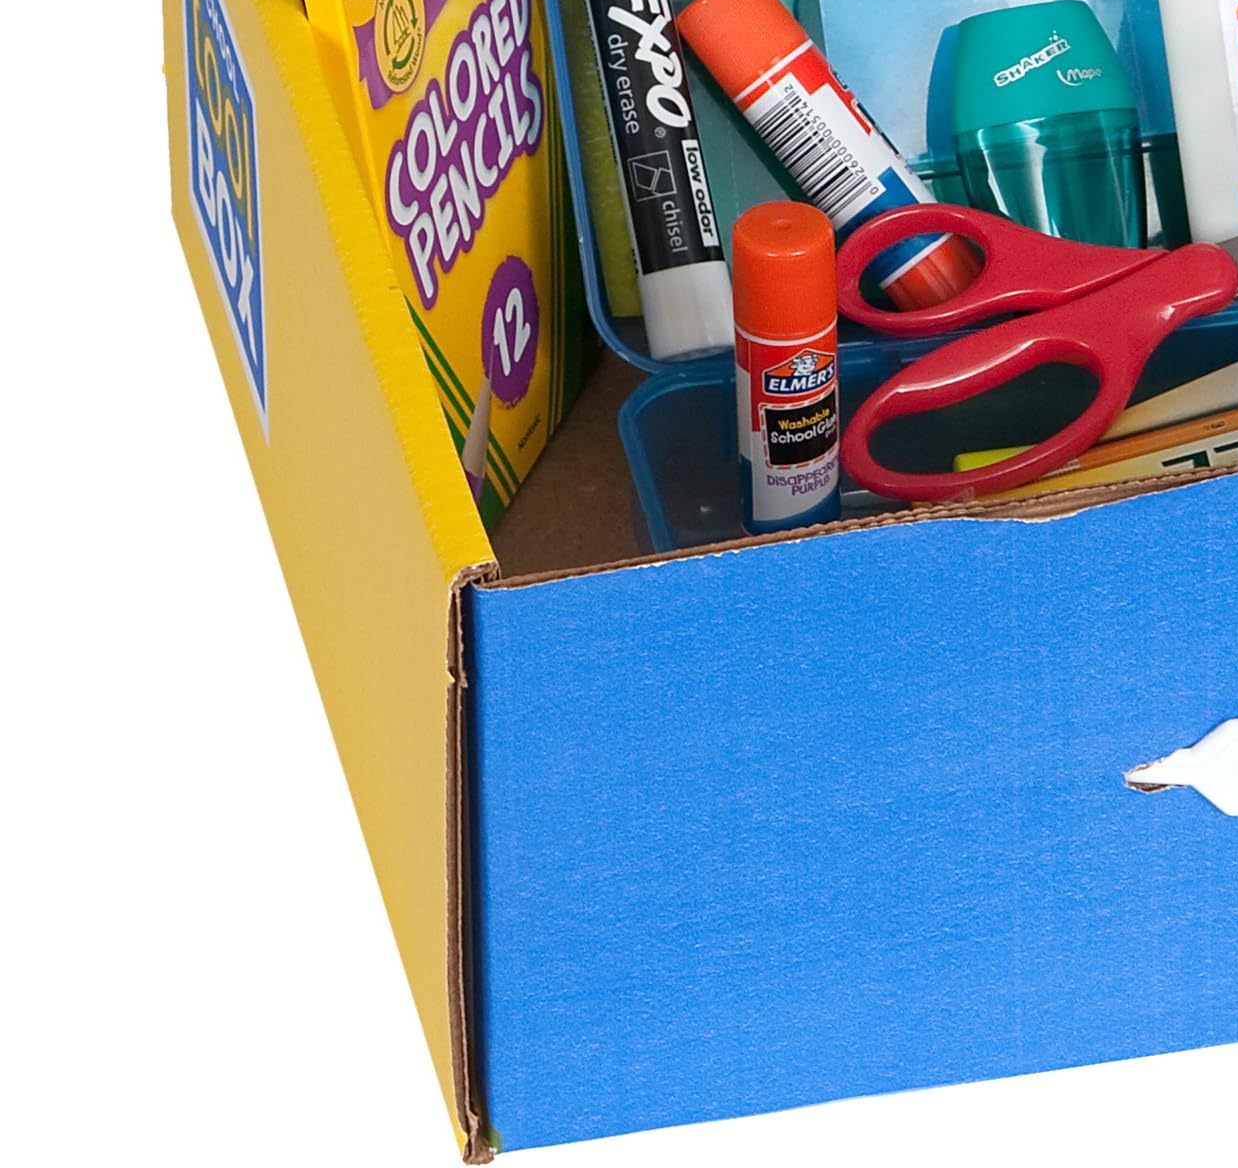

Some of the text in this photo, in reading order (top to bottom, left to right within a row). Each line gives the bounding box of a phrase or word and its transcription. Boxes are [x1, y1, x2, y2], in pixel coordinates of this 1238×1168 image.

[608, 34, 641, 135] dry erase
[996, 41, 1070, 85] SHAKER
[784, 84, 794, 94] 2
[409, 50, 541, 299] PENCILS
[831, 139, 865, 176] 26000
[686, 147, 714, 237] low odor
[870, 186, 880, 196] 0
[196, 97, 258, 365] BOX
[662, 200, 689, 253] chisel
[492, 287, 531, 377] 12
[768, 362, 834, 392] ELMER'S
[771, 426, 816, 444] School
[778, 409, 830, 430] Washable
